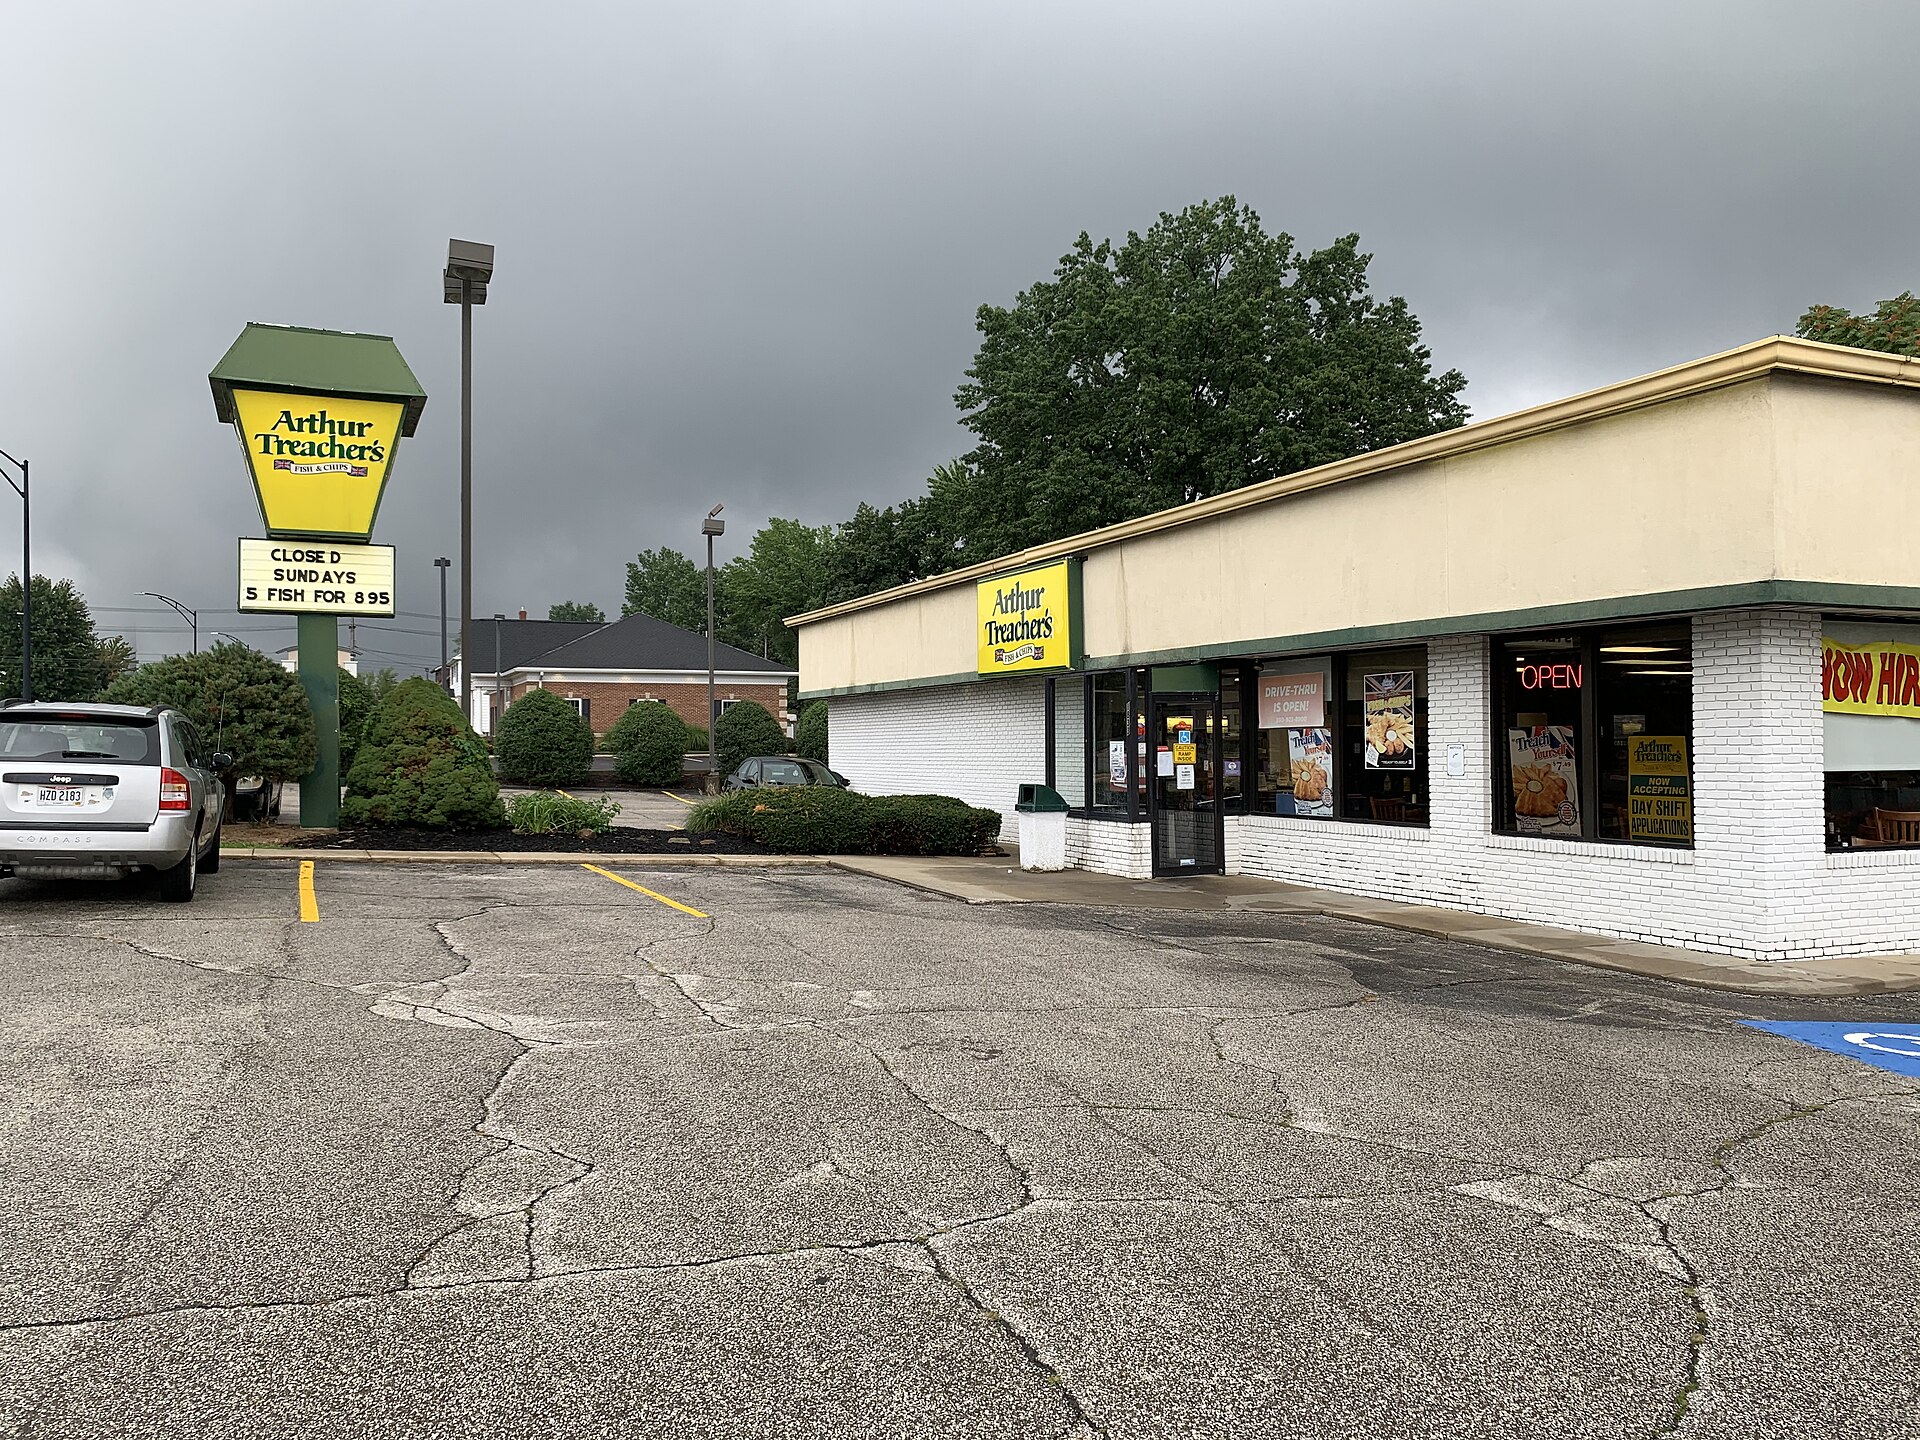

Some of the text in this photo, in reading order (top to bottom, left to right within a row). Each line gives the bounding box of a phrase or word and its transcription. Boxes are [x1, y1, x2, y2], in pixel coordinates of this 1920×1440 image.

[271, 410, 373, 437] Arthur
[254, 433, 385, 462] Treacher's
[294, 463, 349, 473] FISH & CHIPS
[270, 548, 341, 564] CLOSED
[273, 568, 357, 584] SUNDAYS
[245, 587, 258, 600] 5
[267, 588, 305, 602] FISH
[314, 589, 346, 604] FOR
[992, 581, 1045, 617] Arthur
[984, 608, 1053, 646] Treacher's
[1521, 664, 1582, 689] OPEN
[1876, 652, 1920, 707] HIR
[1265, 683, 1318, 698] DRIVE-THRU
[1273, 700, 1310, 713] IS OPEN!
[1635, 739, 1673, 753] Arthur
[1634, 750, 1682, 763] Treacher's
[49, 774, 72, 783] Jeep
[1648, 777, 1671, 786] NOW
[39, 790, 81, 802] HZD 2183
[1633, 785, 1686, 795] ACCEPTING
[1631, 798, 1687, 817] DAY SHIFT
[1631, 817, 1689, 836] APPLICATIONS
[16, 835, 92, 844] COMPASS
